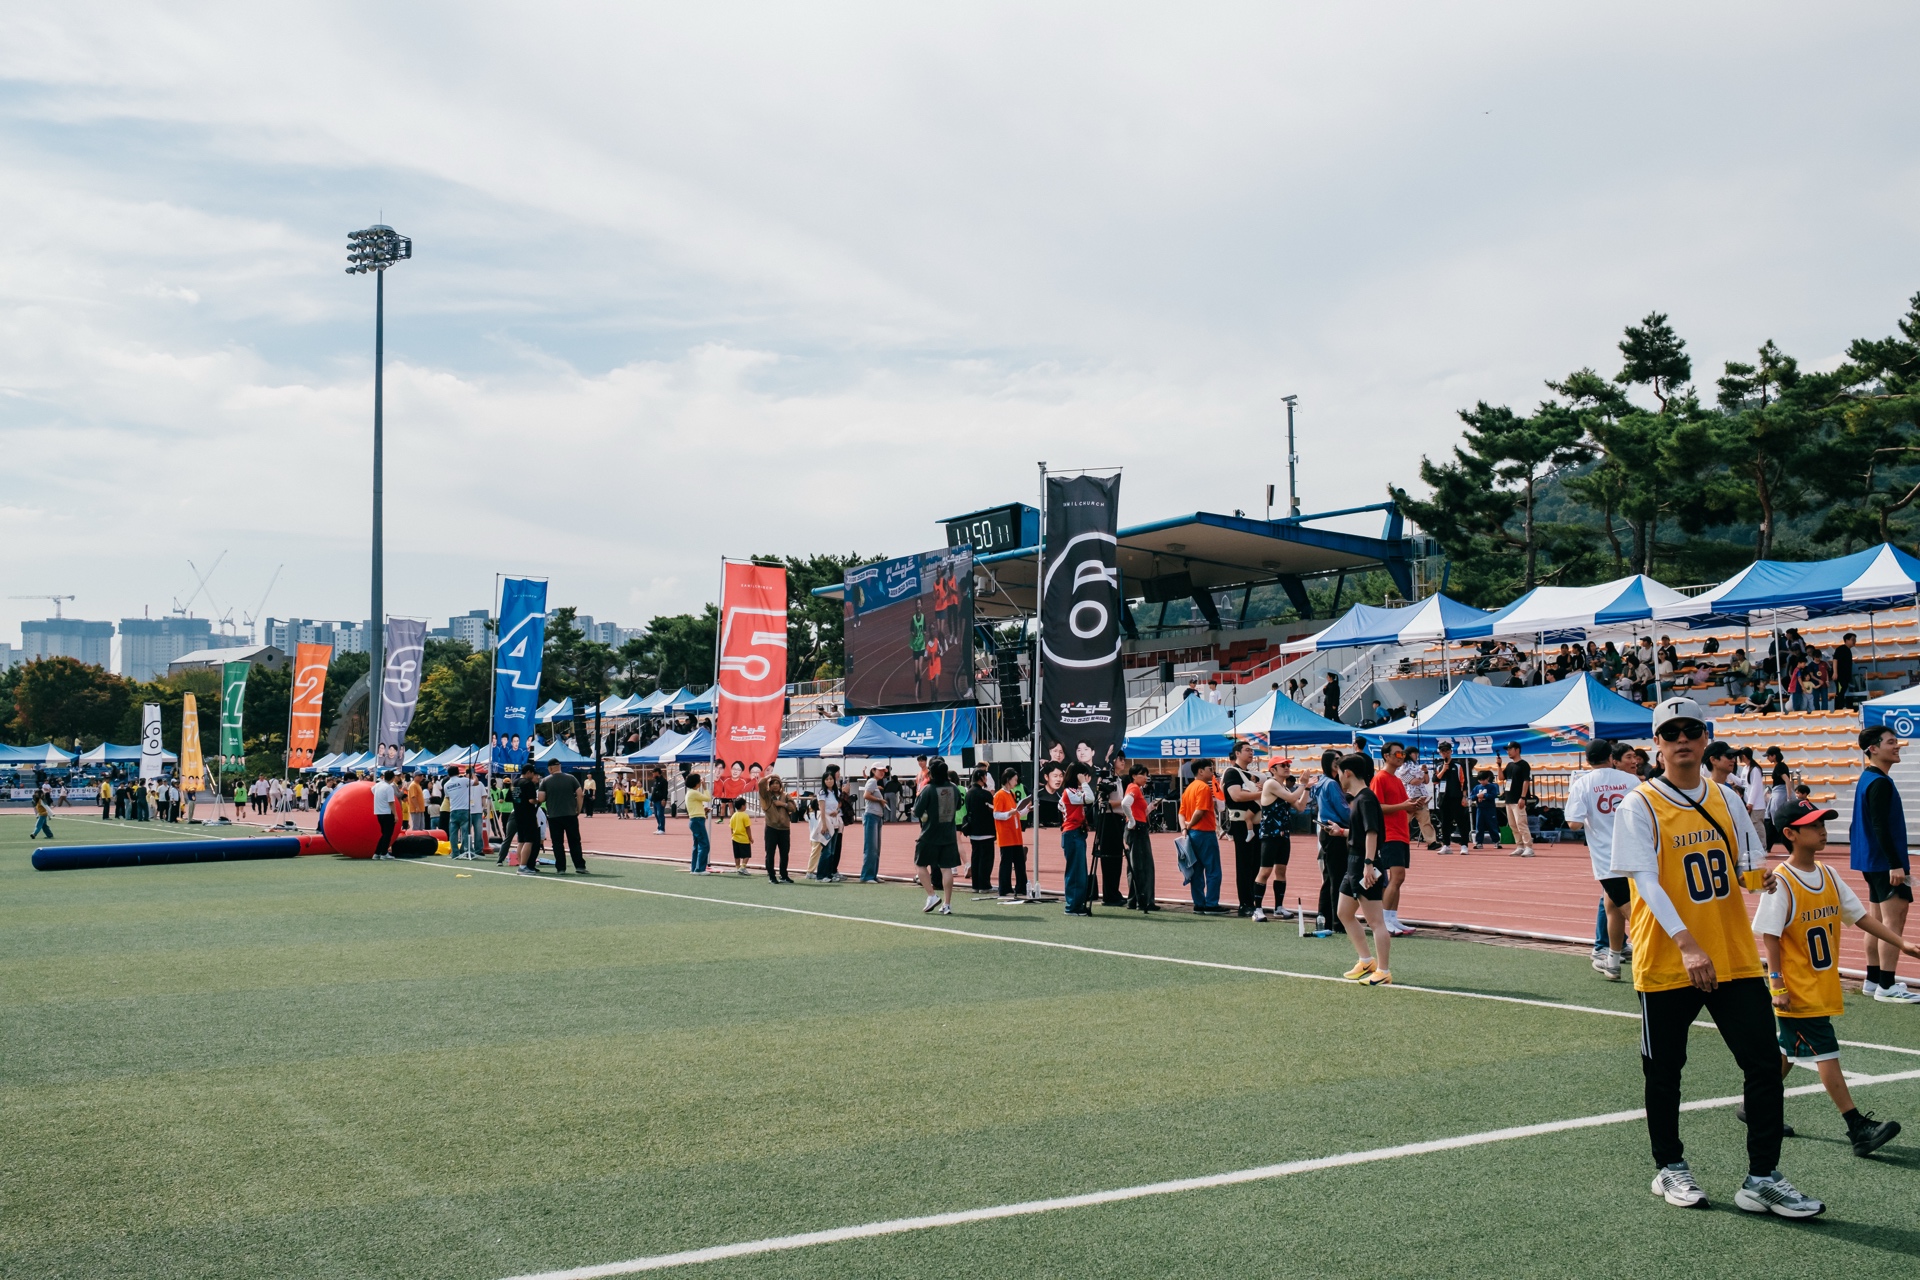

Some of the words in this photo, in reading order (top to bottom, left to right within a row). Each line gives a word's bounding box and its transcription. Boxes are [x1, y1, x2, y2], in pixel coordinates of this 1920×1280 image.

[1043, 531, 1122, 668] 6
[496, 612, 546, 690] 4
[719, 606, 788, 703] 5
[222, 681, 246, 728] 1
[293, 664, 328, 717] 2
[1160, 738, 1201, 756] 음향팀
[1593, 783, 1628, 794] ULTRAMAN
[1683, 848, 1730, 904] 08
